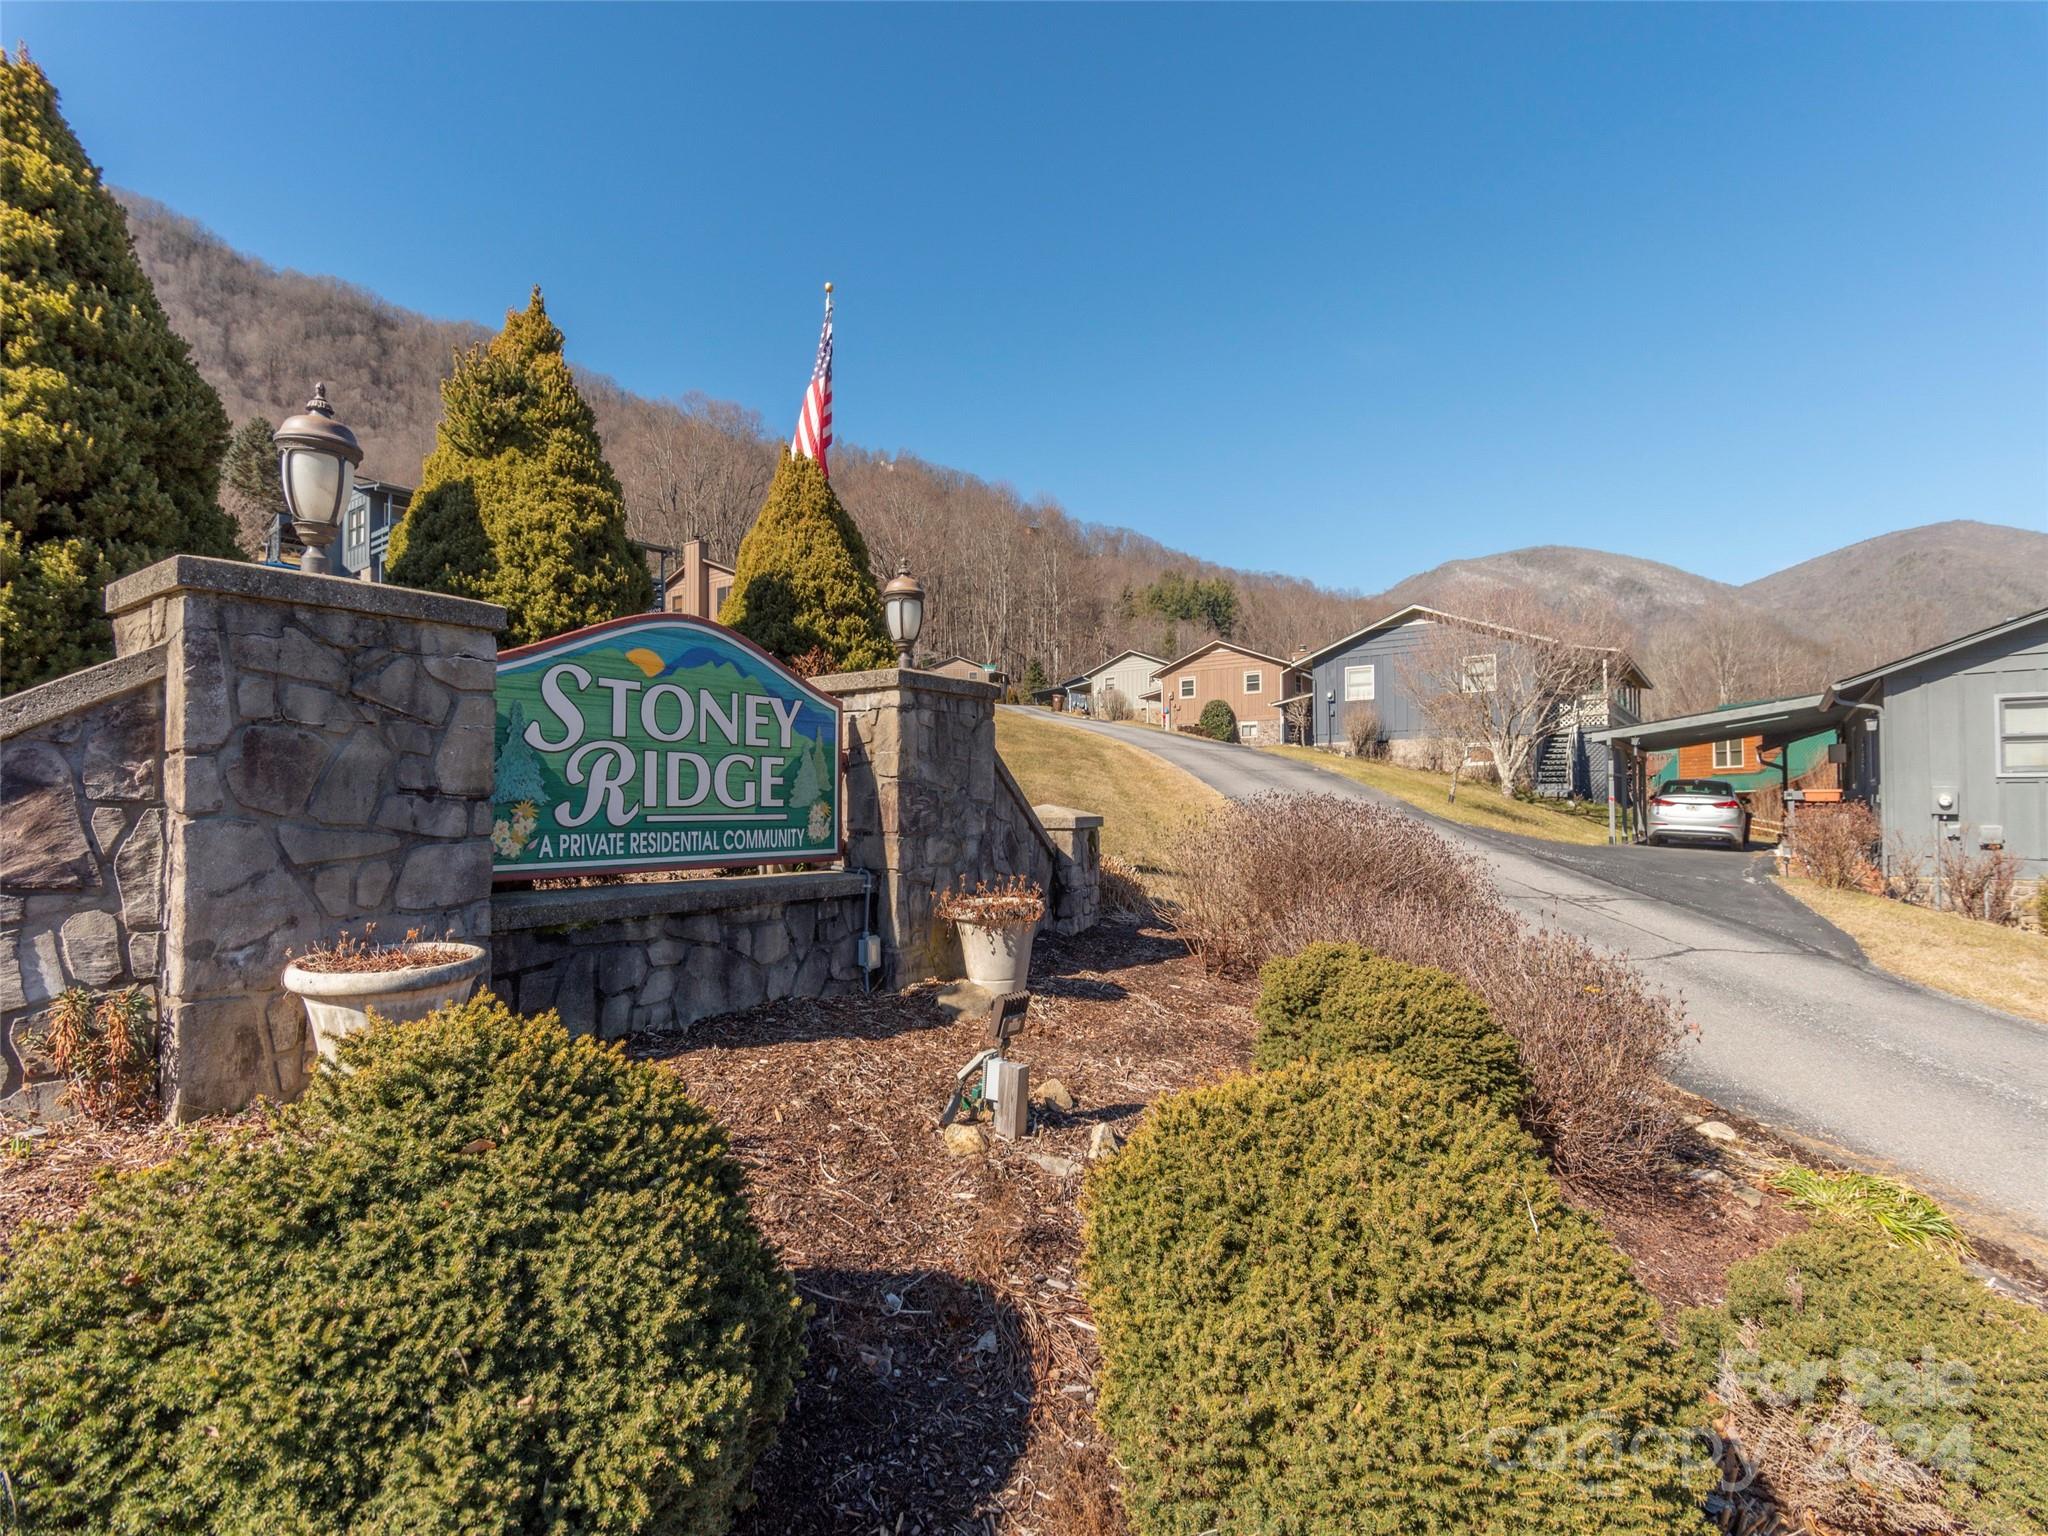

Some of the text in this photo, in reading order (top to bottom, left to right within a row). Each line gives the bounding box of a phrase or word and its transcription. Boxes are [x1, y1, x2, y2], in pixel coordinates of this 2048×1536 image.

[523, 663, 803, 751] STONEY
[553, 740, 785, 828] RIDGE
[538, 828, 805, 859] A PRIVATE RESIDENTIAL COMMUNITY
